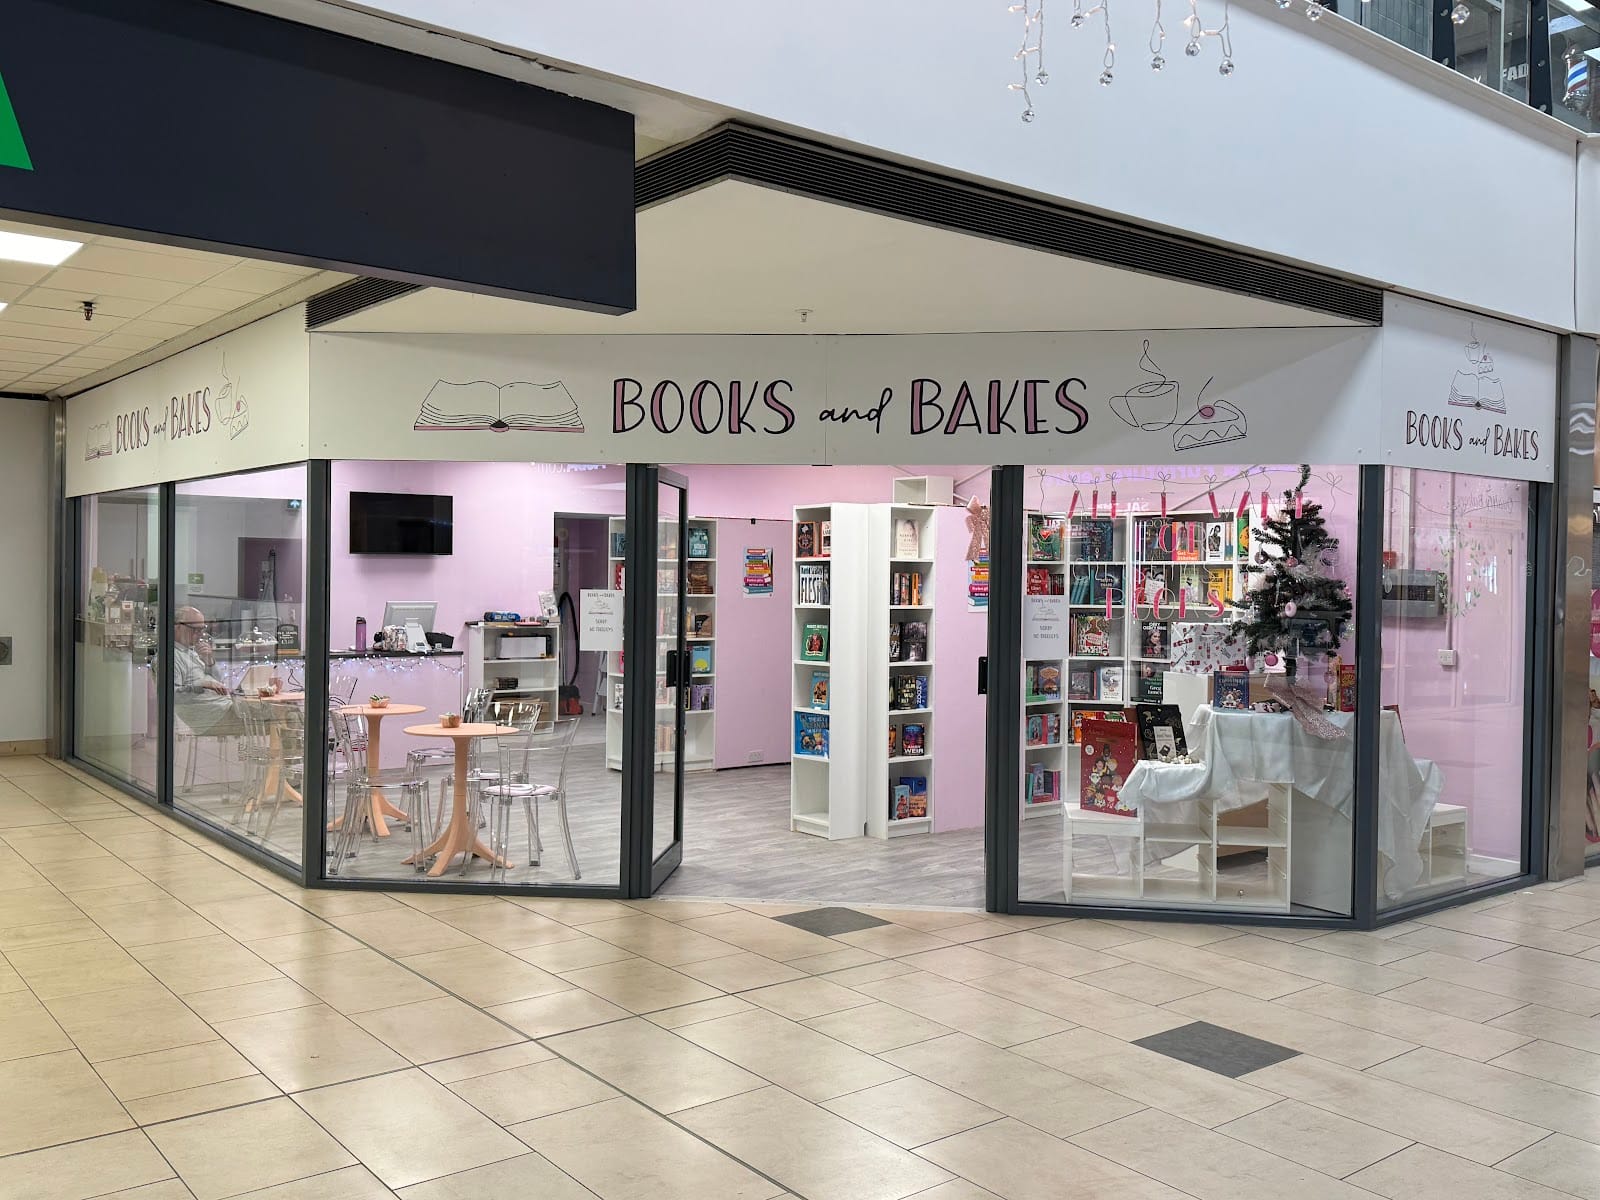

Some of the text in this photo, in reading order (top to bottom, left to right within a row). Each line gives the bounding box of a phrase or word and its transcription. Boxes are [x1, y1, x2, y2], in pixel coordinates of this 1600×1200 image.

[116, 386, 211, 454] BOOKS and BAKES
[613, 377, 1089, 434] BOOKS and BAKES
[1406, 410, 1539, 461] BOOKS and BAKES
